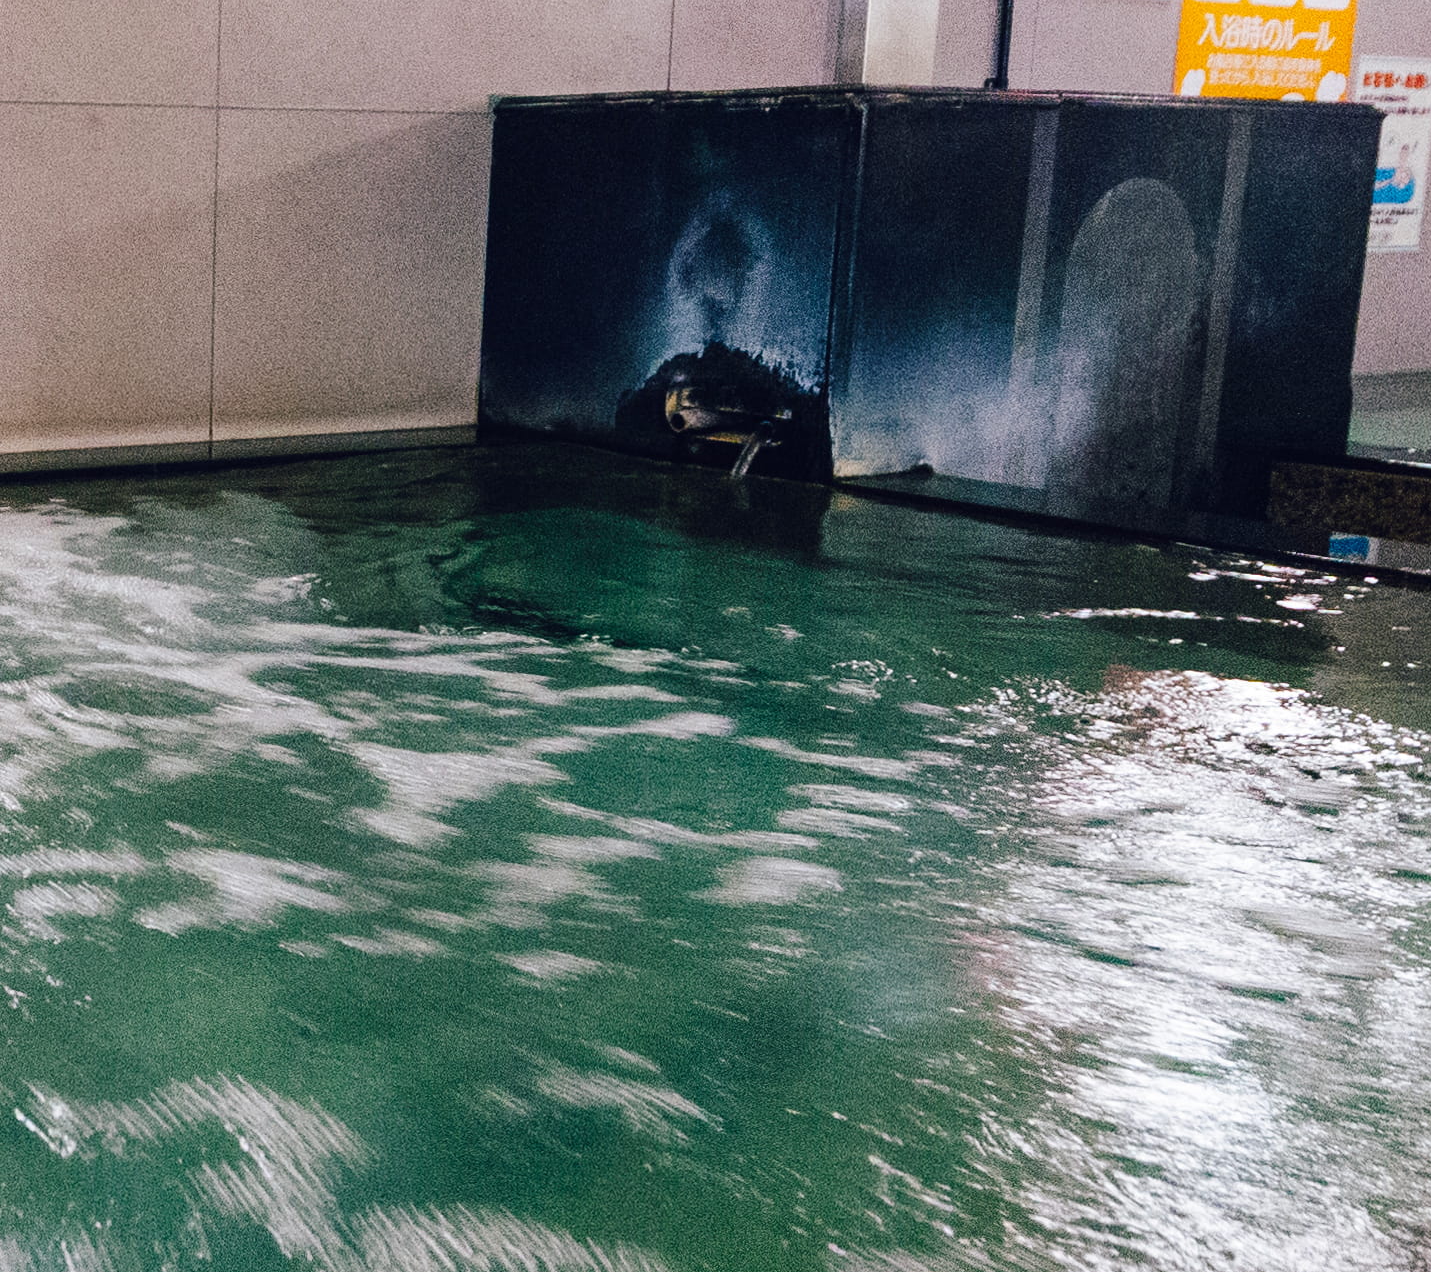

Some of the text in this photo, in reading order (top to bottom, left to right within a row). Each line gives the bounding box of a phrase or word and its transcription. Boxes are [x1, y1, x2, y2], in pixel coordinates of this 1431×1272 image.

[1198, 12, 1336, 52] 入浴時のルール
